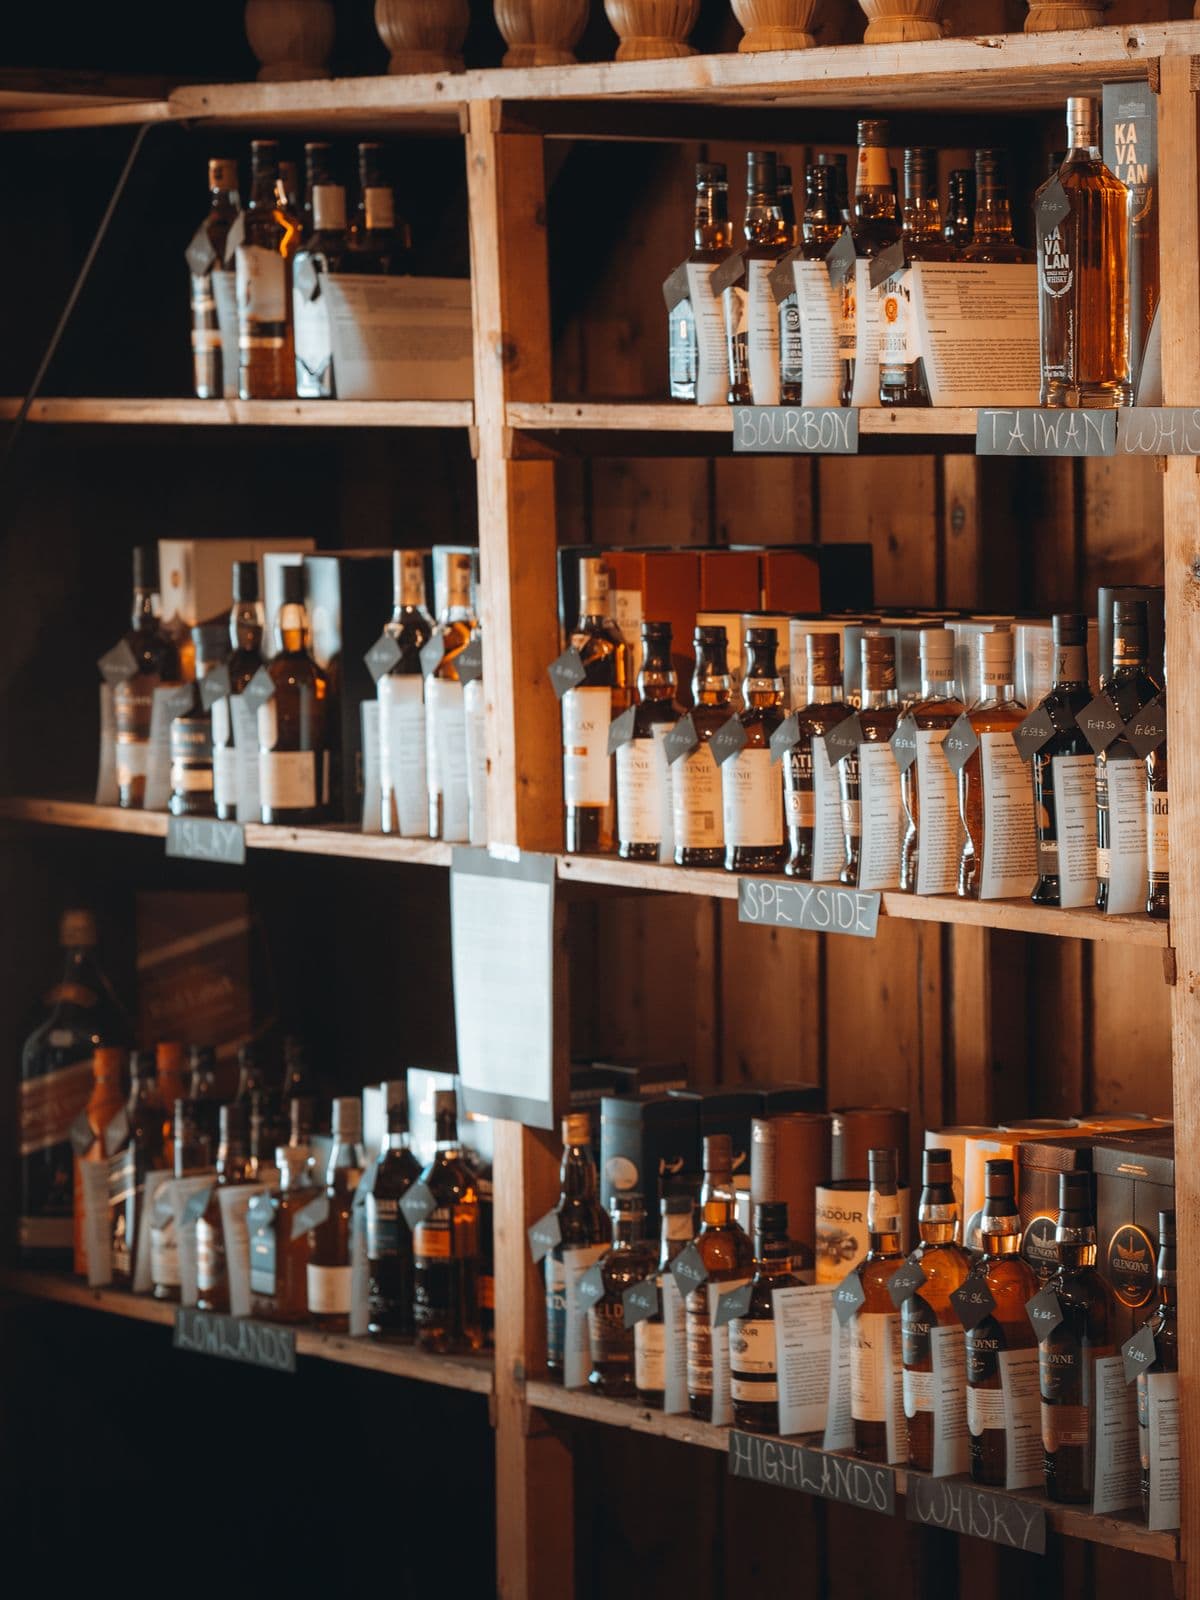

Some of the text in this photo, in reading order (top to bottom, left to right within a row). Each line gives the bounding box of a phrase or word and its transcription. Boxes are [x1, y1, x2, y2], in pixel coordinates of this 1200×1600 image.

[1115, 123, 1137, 144] KA
[1115, 144, 1137, 164] VA
[1115, 164, 1148, 184] LAN
[1045, 226, 1061, 240] A
[1044, 240, 1061, 255] VA
[1044, 254, 1070, 269] LAN
[740, 410, 851, 449] BOURBON
[984, 410, 1107, 452] TAIWAN
[175, 820, 238, 857] ISLAY
[742, 881, 874, 931] SPEYSIDE
[1026, 1245, 1059, 1259] GLENGOYN
[1112, 1258, 1150, 1273] GLENGOYNE
[733, 1434, 888, 1512] HIGHLANDS
[914, 1478, 1039, 1551] WHISKY
